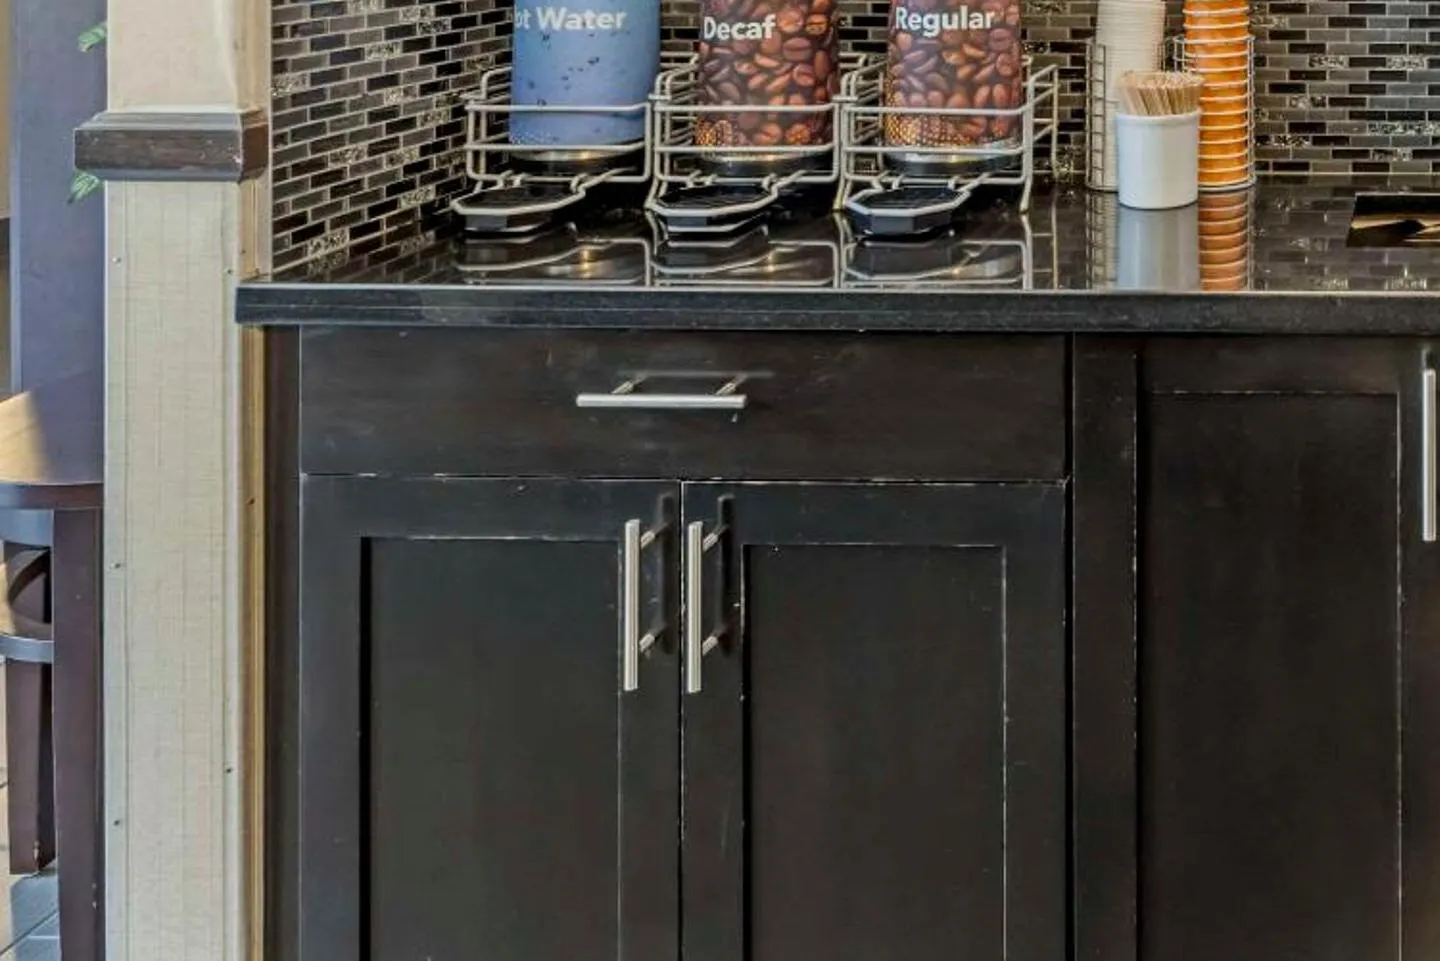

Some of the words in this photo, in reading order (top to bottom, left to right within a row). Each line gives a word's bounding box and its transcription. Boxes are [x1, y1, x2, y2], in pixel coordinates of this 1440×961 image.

[514, 5, 532, 30] ot
[535, 5, 628, 31] Water
[703, 13, 777, 40] Decaf
[895, 4, 996, 38] Regular
